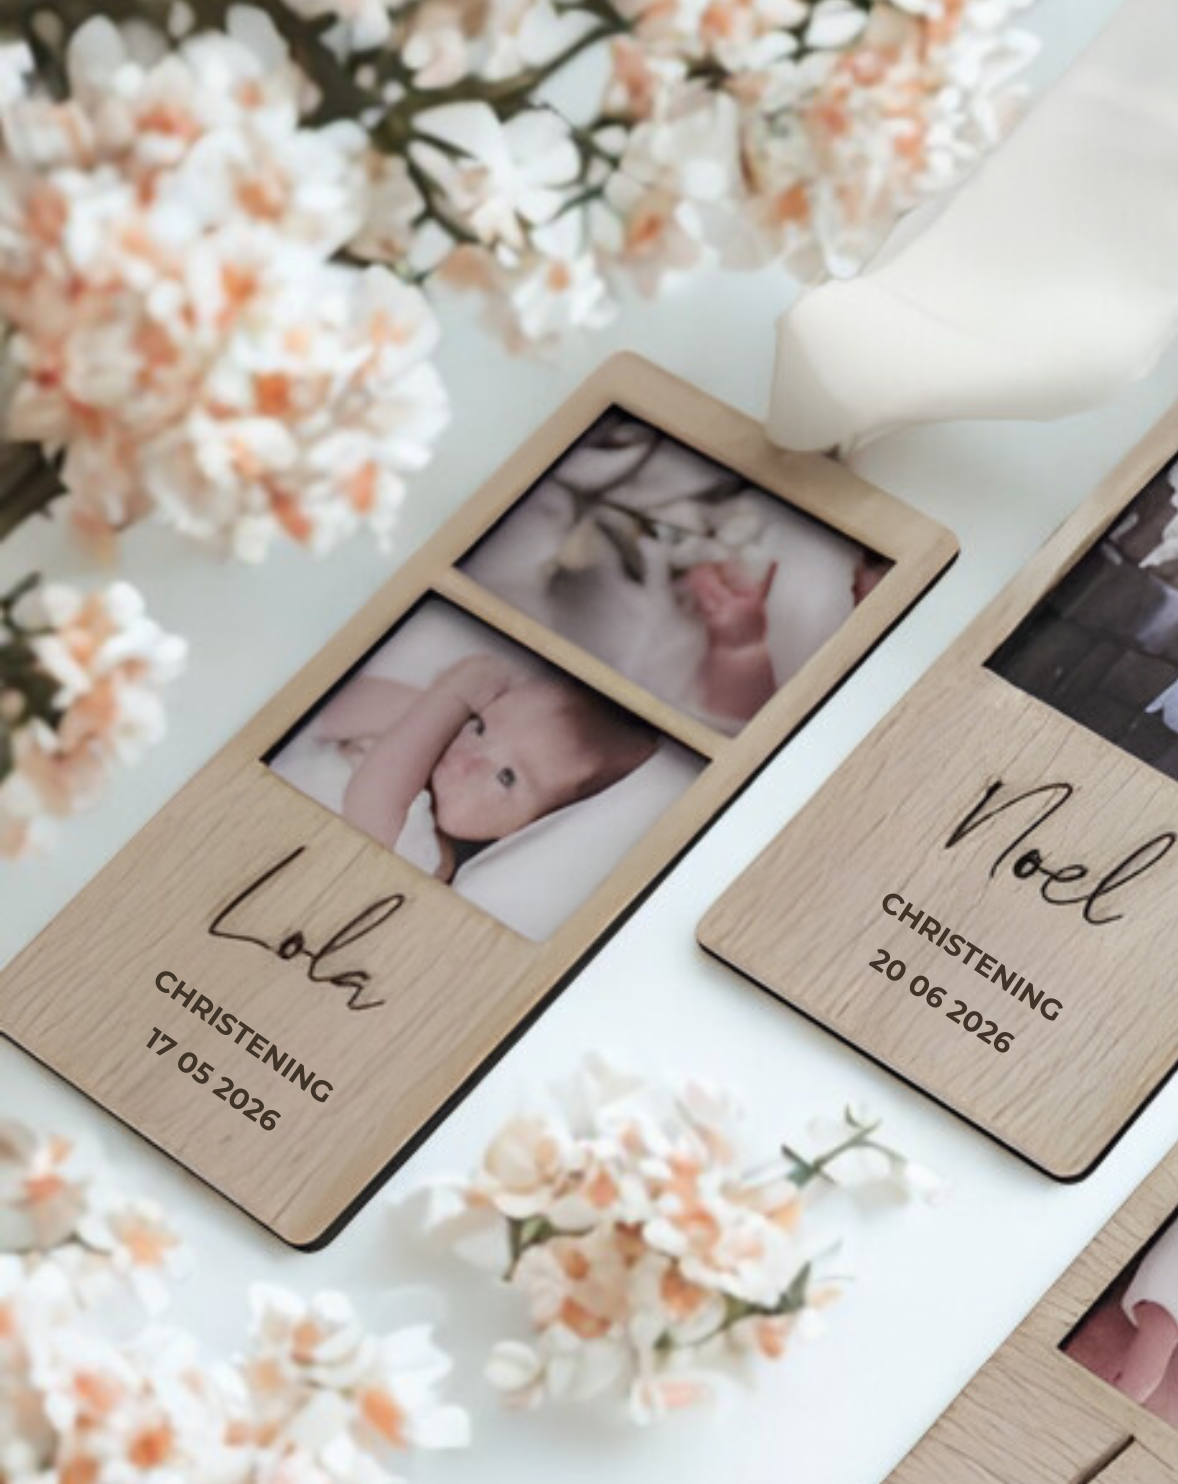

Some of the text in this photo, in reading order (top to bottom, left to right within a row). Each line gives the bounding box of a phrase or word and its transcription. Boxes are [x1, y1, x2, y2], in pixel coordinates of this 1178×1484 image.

[945, 780, 1177, 925] Noel
[208, 845, 405, 1010] Lola
[882, 893, 1064, 1022] CHRISTENING
[155, 971, 334, 1103] CHRISTENING
[868, 949, 1016, 1053] 20 06 2026
[146, 1027, 281, 1131] 17 05 2026
